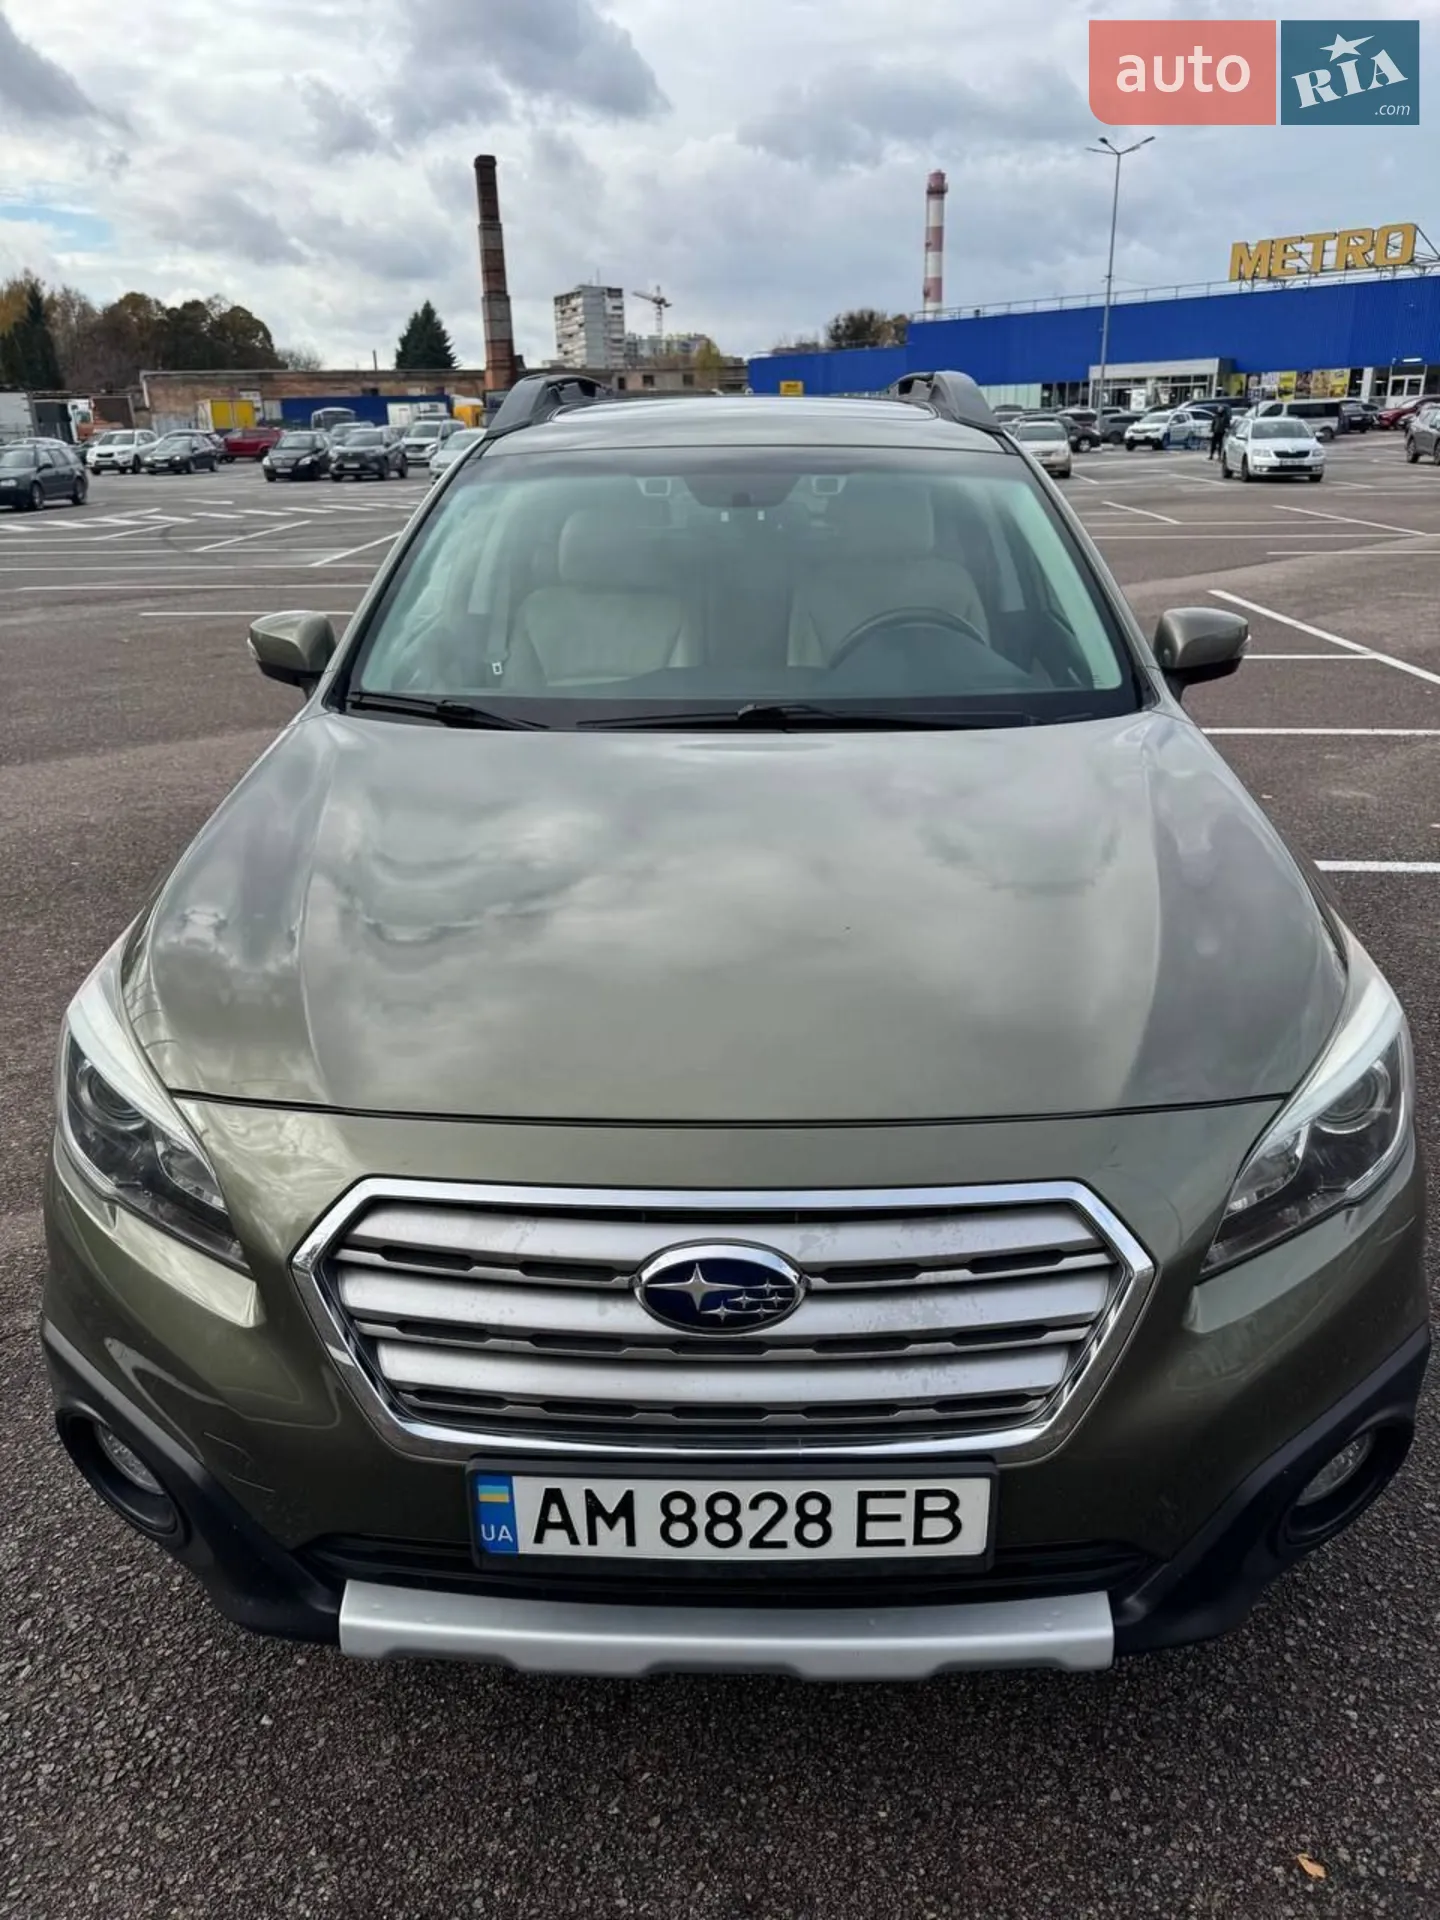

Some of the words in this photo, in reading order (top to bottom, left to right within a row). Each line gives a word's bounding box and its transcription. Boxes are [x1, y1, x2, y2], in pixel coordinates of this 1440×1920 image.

[1229, 223, 1417, 281] METRO
[480, 1523, 514, 1543] UA
[533, 1487, 637, 1547] AM
[658, 1490, 833, 1549] 8828
[855, 1489, 963, 1548] EB
